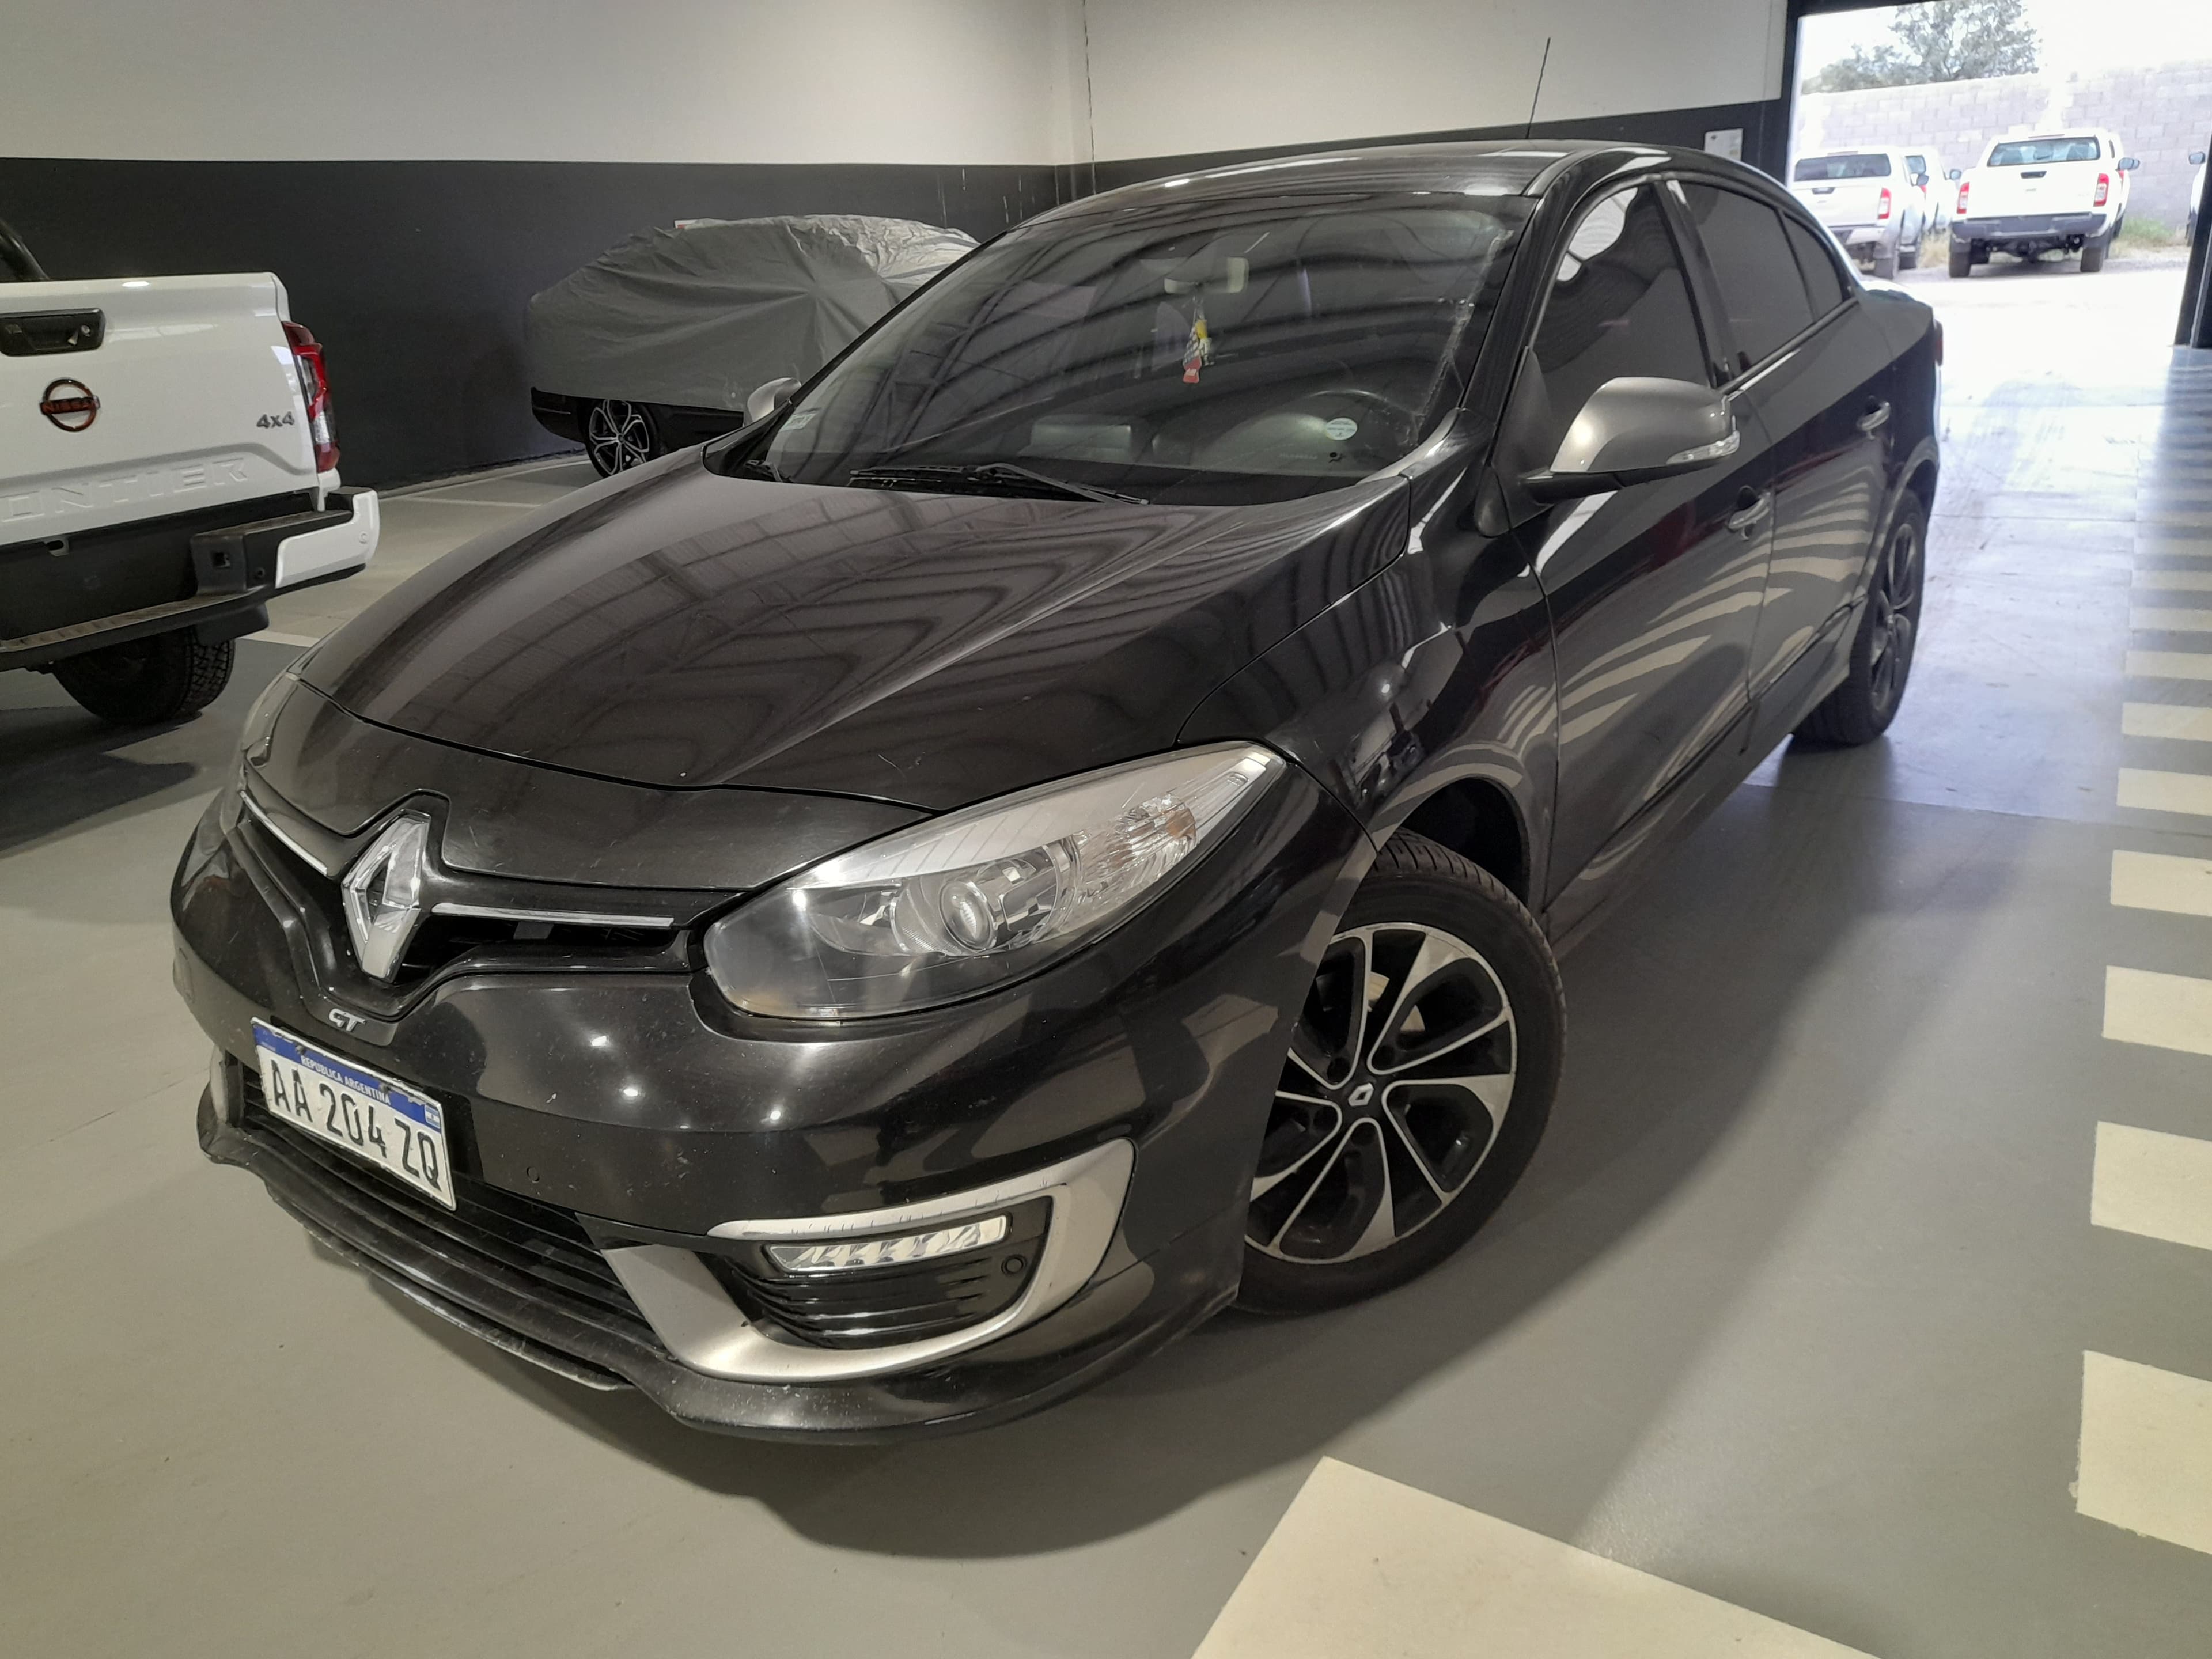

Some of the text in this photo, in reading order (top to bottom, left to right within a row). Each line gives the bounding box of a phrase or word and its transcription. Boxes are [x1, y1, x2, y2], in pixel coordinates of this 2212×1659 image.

[256, 411, 294, 429] 4x4
[329, 1008, 365, 1032] GT
[300, 1055, 391, 1105] REPUBLICA ARGENTINA
[271, 1059, 442, 1192] AA 204 ZQ
